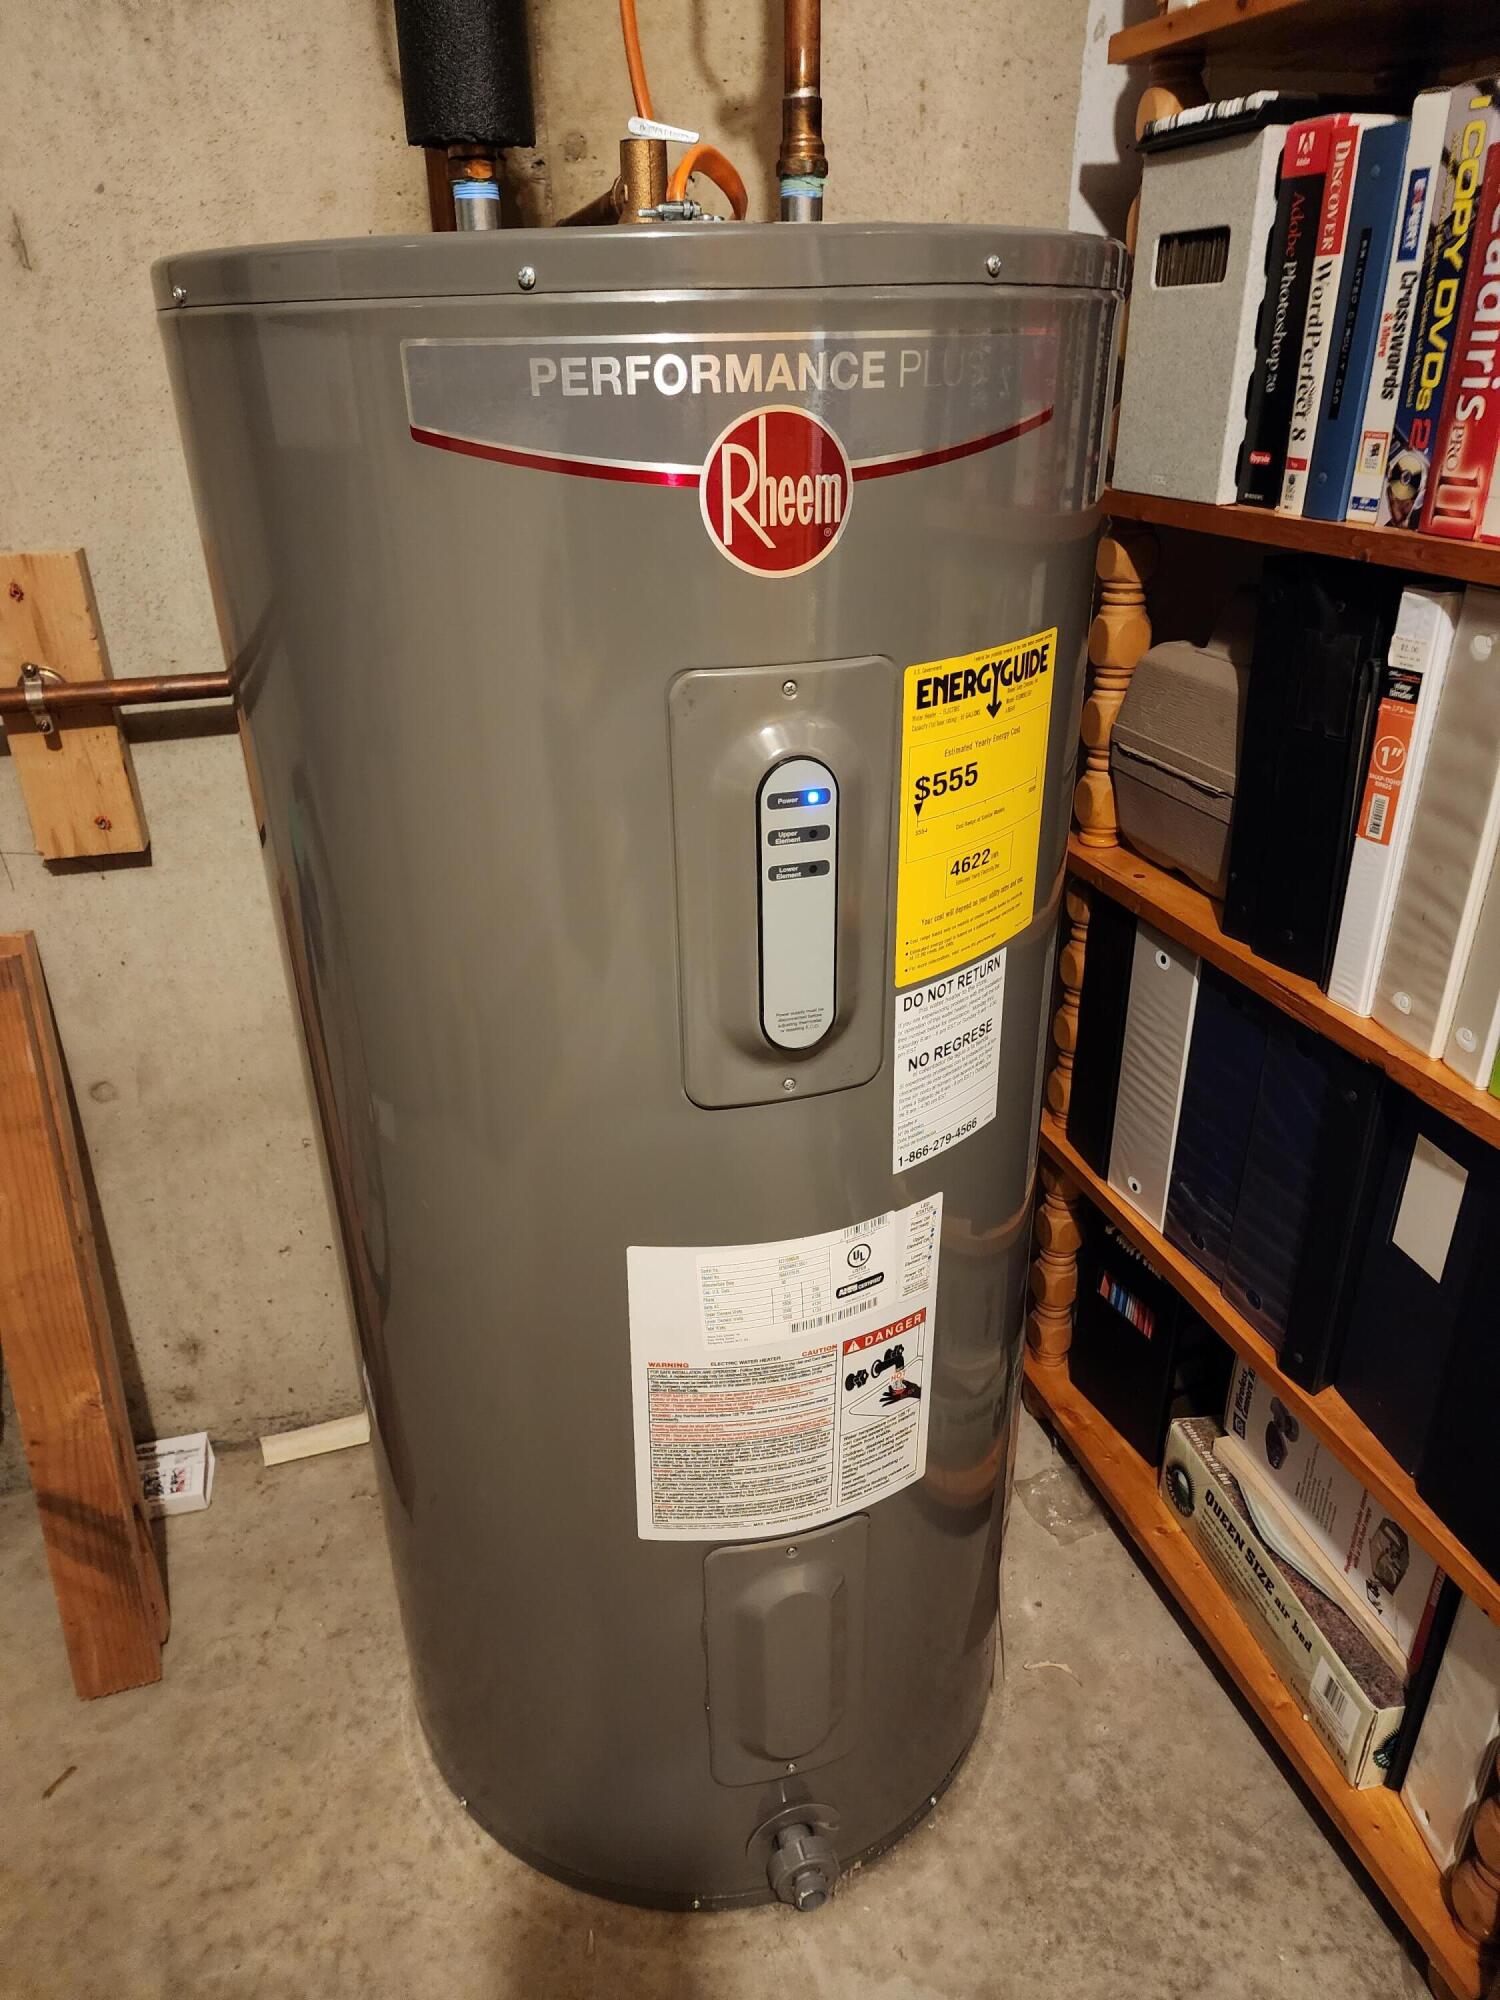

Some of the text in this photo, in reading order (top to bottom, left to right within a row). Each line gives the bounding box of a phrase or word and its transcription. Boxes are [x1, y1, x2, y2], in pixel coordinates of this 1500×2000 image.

[1321, 139, 1352, 250] DISCOVER
[1443, 119, 1487, 271] COPY
[1285, 191, 1305, 258] Adobe
[1265, 259, 1298, 371] Photoshop
[1375, 271, 1417, 401] Crosswords
[1292, 260, 1333, 442] WordPerfect 8
[1377, 324, 1392, 358] More
[1415, 278, 1458, 411] DVDs
[529, 351, 884, 397] PERFORMANCE
[1409, 418, 1431, 449] 2
[1447, 423, 1465, 472] PRO
[722, 414, 841, 548] Rheem
[916, 643, 1050, 712] ENERGYGUIDE
[944, 726, 1021, 757] Estimated Yearly Energy Cost
[914, 762, 978, 801] $555
[776, 871, 801, 879] Element
[949, 848, 991, 876] 4622
[921, 919, 933, 927] Your
[934, 912, 944, 923] cost
[955, 902, 972, 916] depend
[903, 954, 1000, 1012] DO NOT RETURN
[908, 1052, 929, 1072] NO
[934, 1018, 993, 1061] REGRESE
[898, 1117, 978, 1166] 1-866-279-4566
[853, 1250, 866, 1261] UL
[801, 1344, 838, 1357] CAUTION
[864, 1313, 922, 1346] DANGER
[891, 1371, 906, 1381] HOT
[1205, 1488, 1313, 1654] QUEEN SIZE air bed
